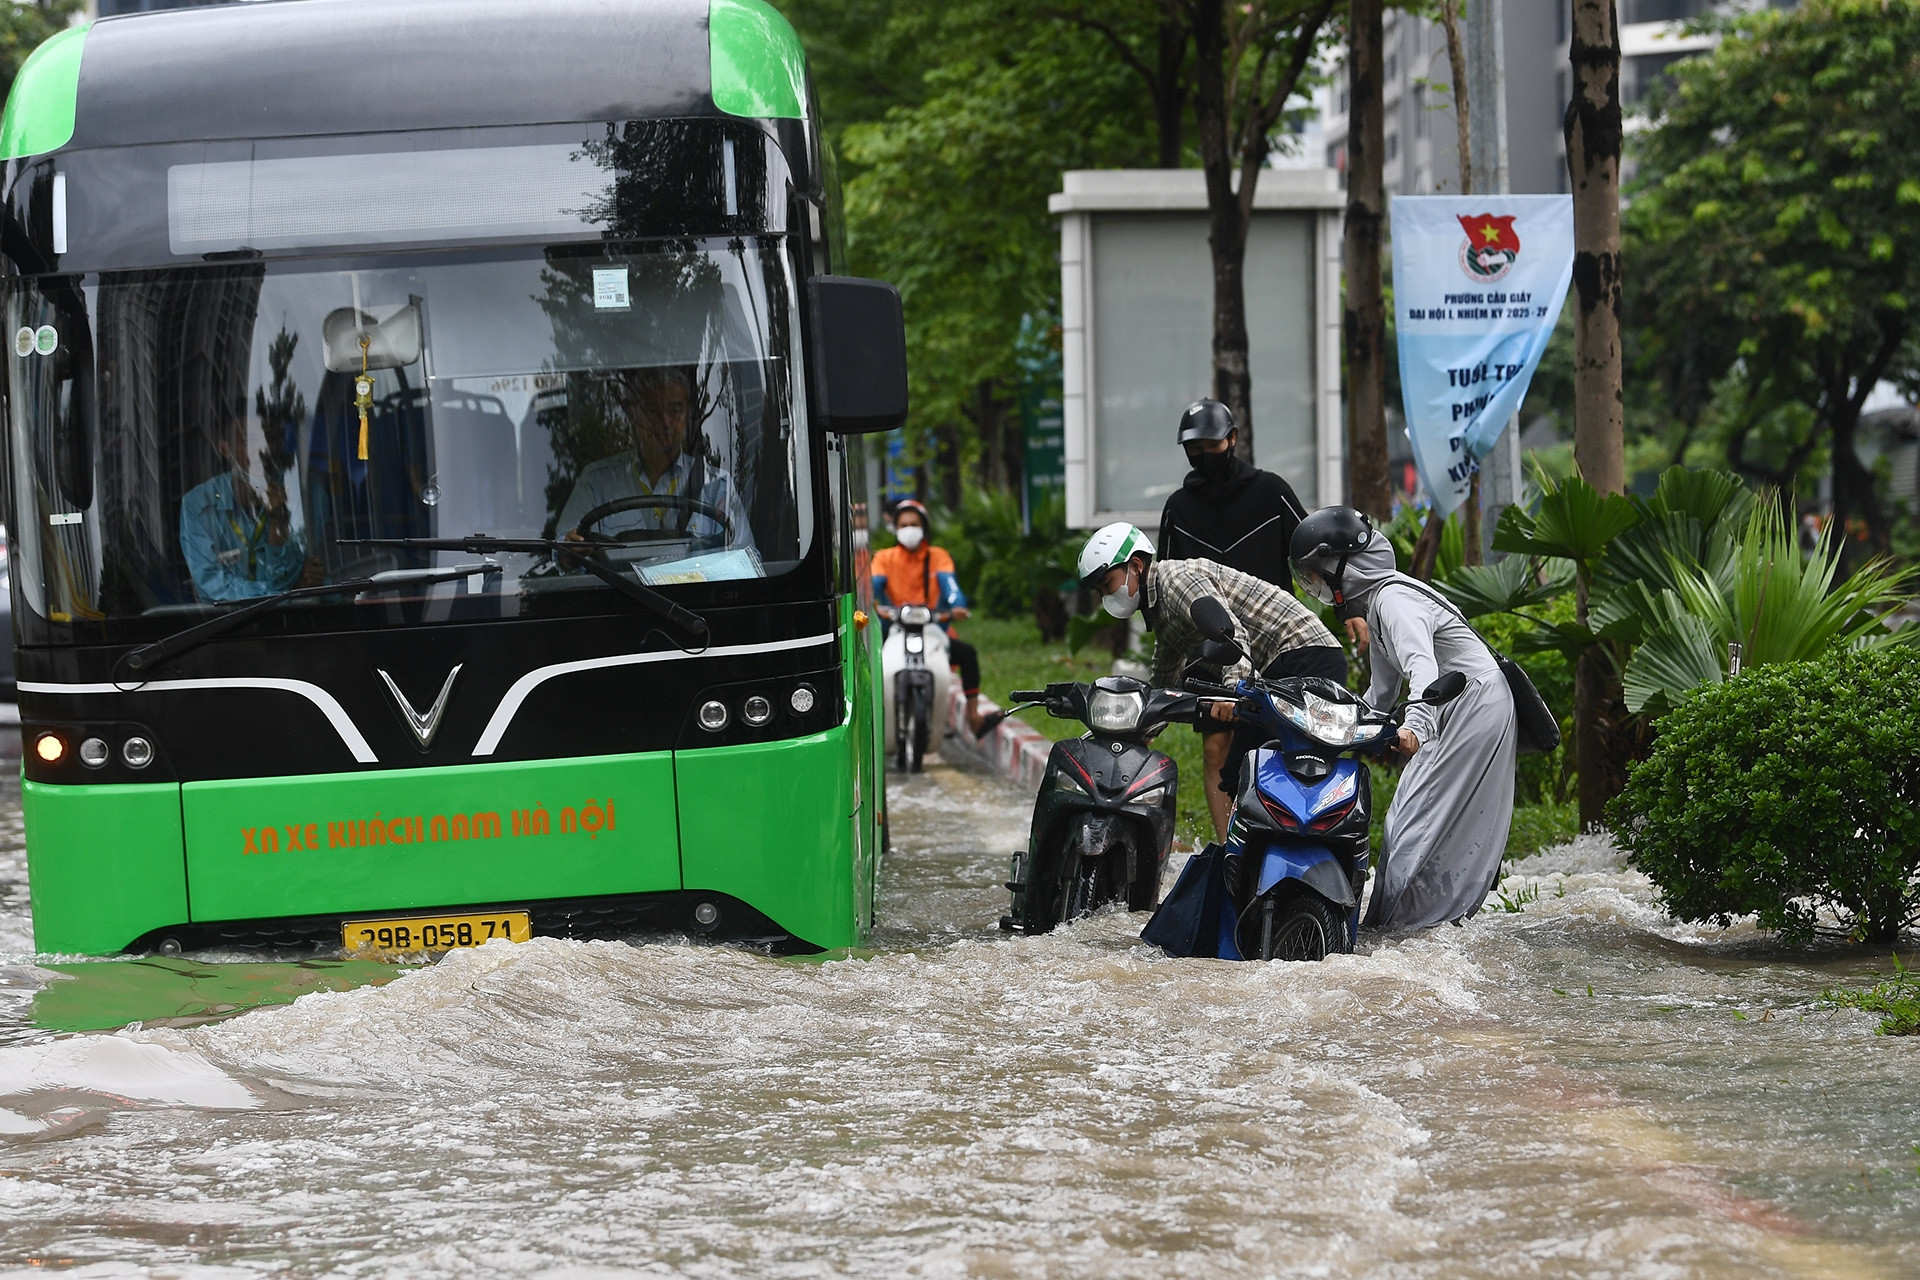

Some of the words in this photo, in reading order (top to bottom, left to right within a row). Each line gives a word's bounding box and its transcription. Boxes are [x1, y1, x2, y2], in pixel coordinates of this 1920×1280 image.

[1507, 307, 1530, 318] 2025
[1295, 754, 1326, 764] HONDA
[241, 826, 280, 855] XN
[285, 823, 320, 852] XE
[327, 811, 425, 849] KHÁCH
[430, 811, 502, 842] NAM
[511, 801, 550, 837] HÀ
[560, 798, 616, 840] NỘI
